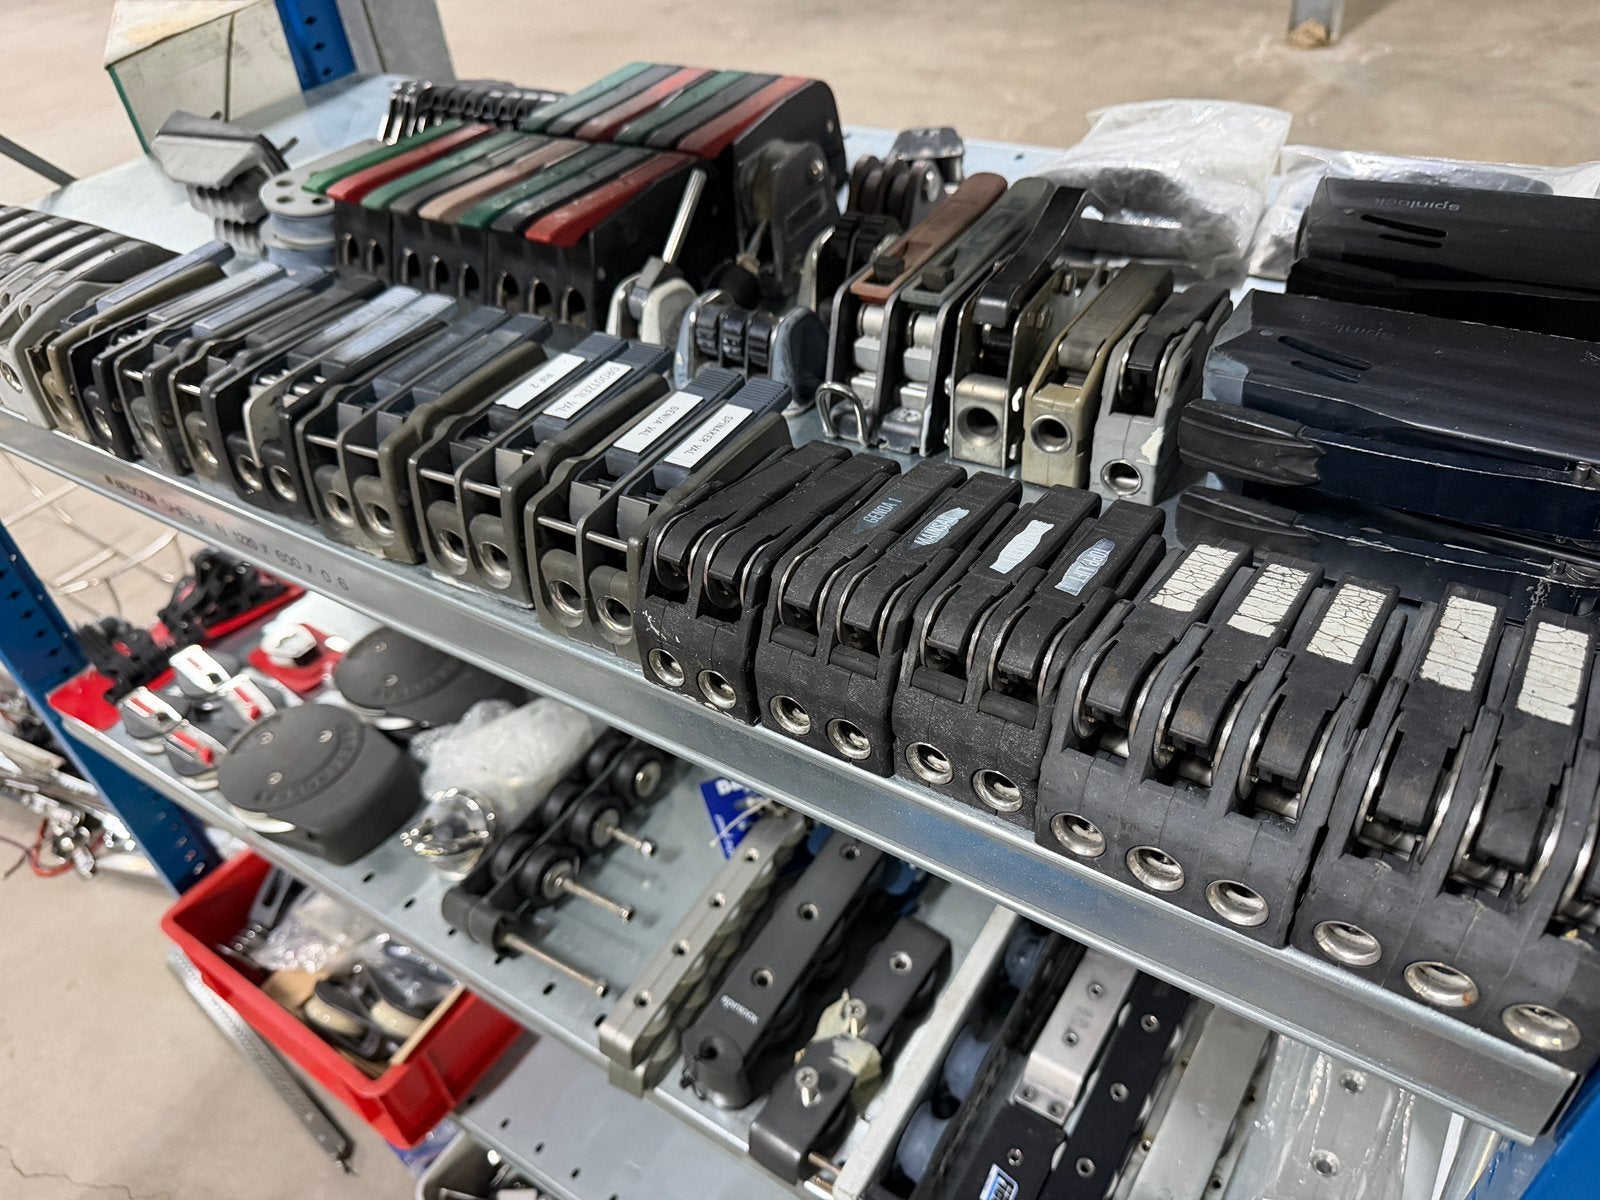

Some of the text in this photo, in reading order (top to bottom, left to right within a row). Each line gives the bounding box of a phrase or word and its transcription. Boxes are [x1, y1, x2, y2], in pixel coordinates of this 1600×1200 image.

[1375, 198, 1461, 211] spinlock
[556, 400, 575, 413] VAL
[639, 406, 680, 437] GENUA VAL
[684, 415, 734, 455] SPINAKER VAL
[863, 501, 898, 524] GENOA
[914, 512, 957, 546] MAINSAIL
